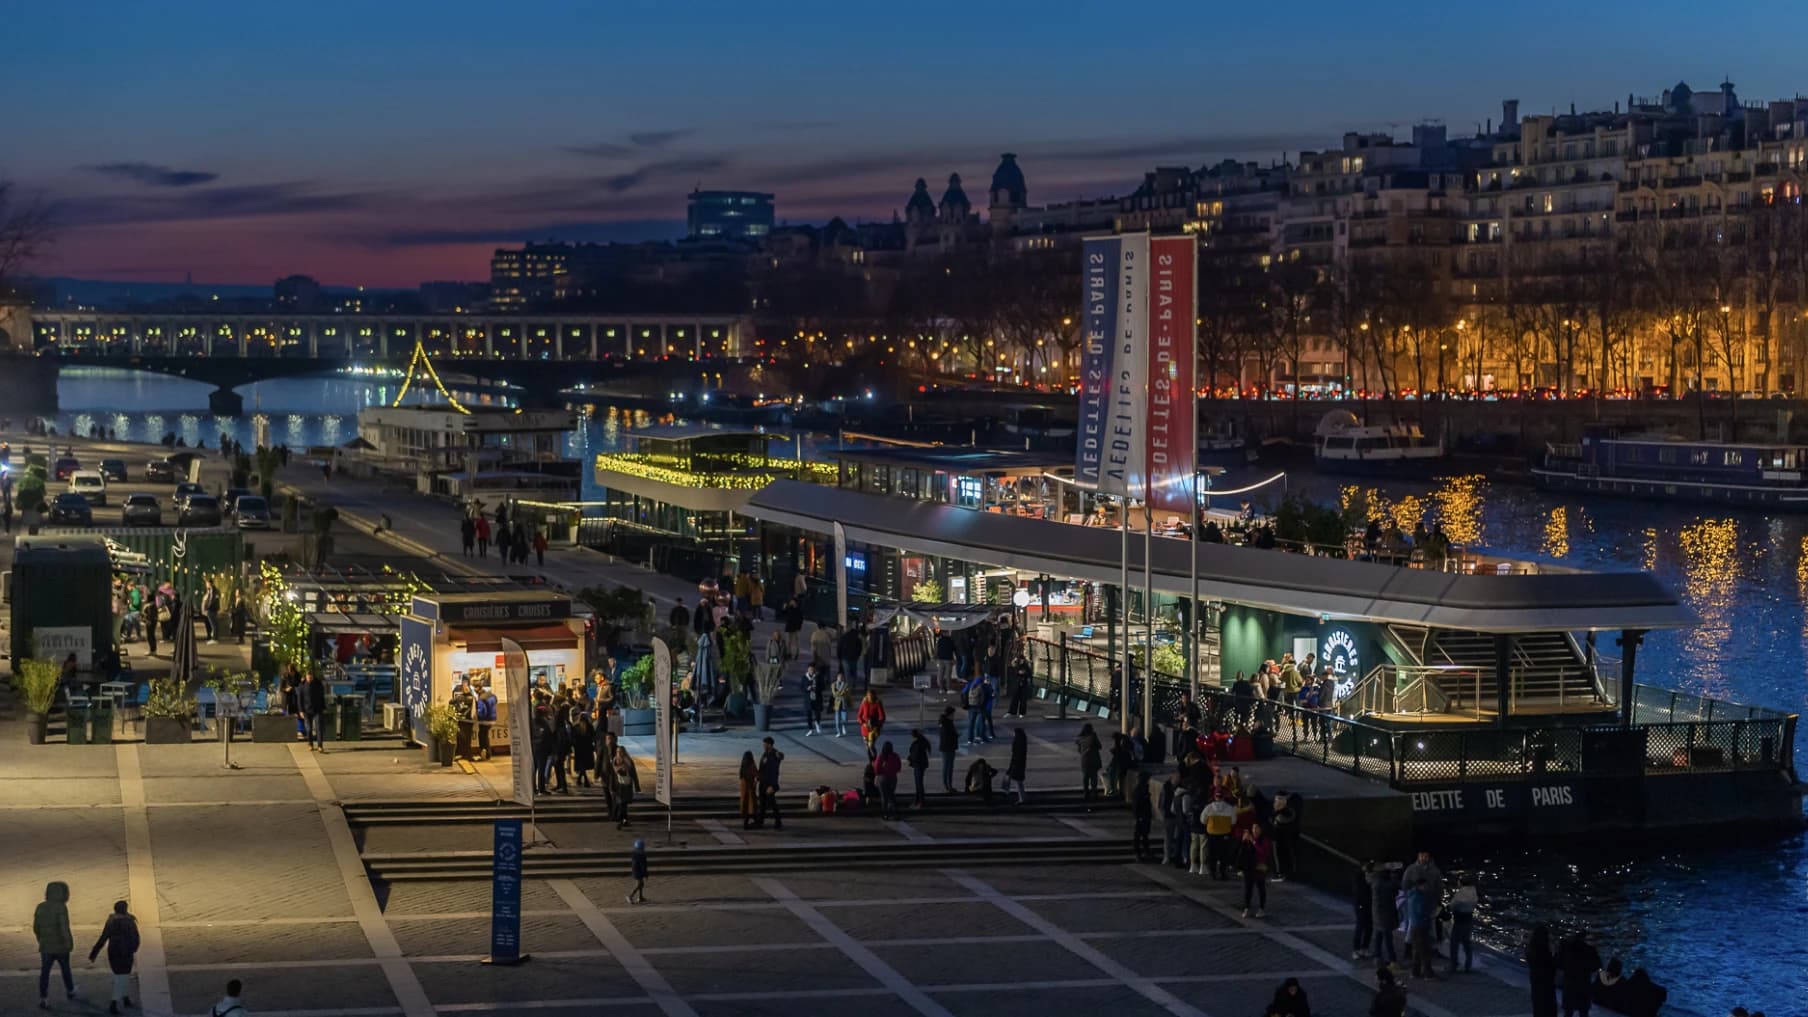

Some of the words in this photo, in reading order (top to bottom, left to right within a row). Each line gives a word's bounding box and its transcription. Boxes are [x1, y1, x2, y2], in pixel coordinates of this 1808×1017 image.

[405, 643, 428, 679] VEDETTES
[1411, 789, 1465, 811] EDETTE
[1485, 788, 1506, 809] DE
[1532, 785, 1574, 807] PARIS
